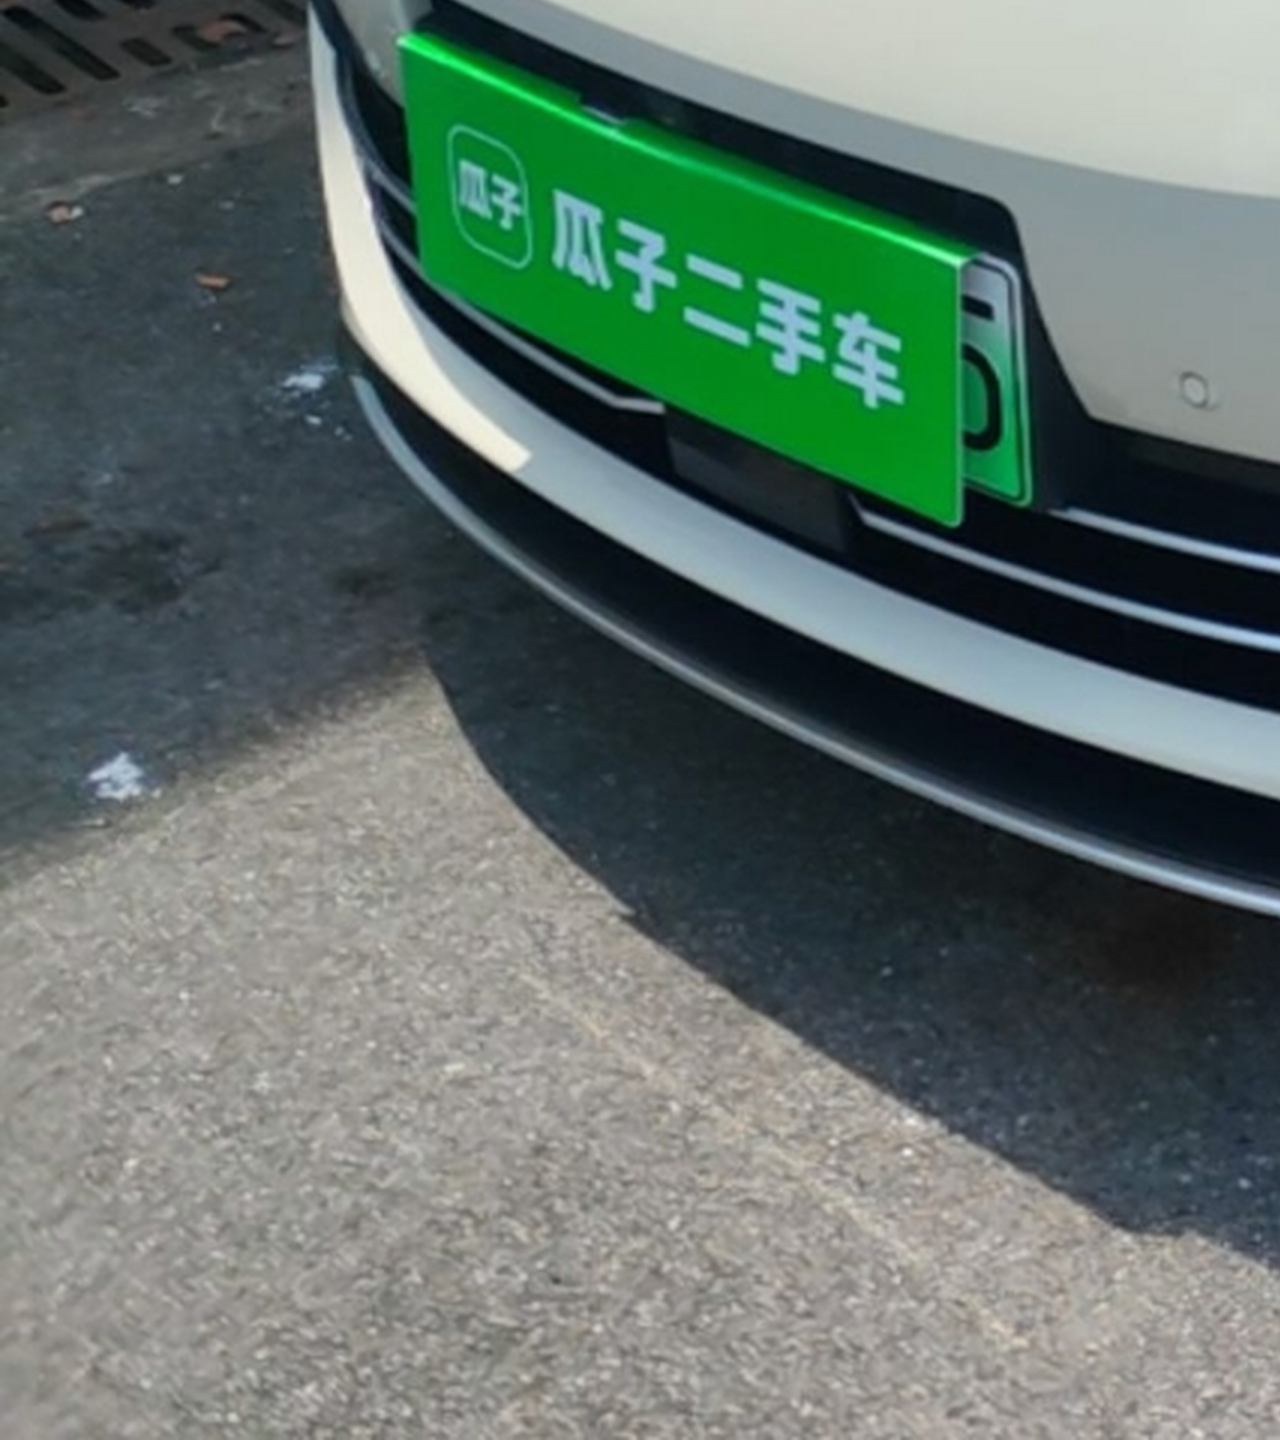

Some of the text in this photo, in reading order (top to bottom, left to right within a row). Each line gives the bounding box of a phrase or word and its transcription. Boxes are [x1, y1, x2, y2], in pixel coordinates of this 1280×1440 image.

[458, 159, 522, 231] 瓜子
[551, 188, 906, 409] 瓜子二手车
